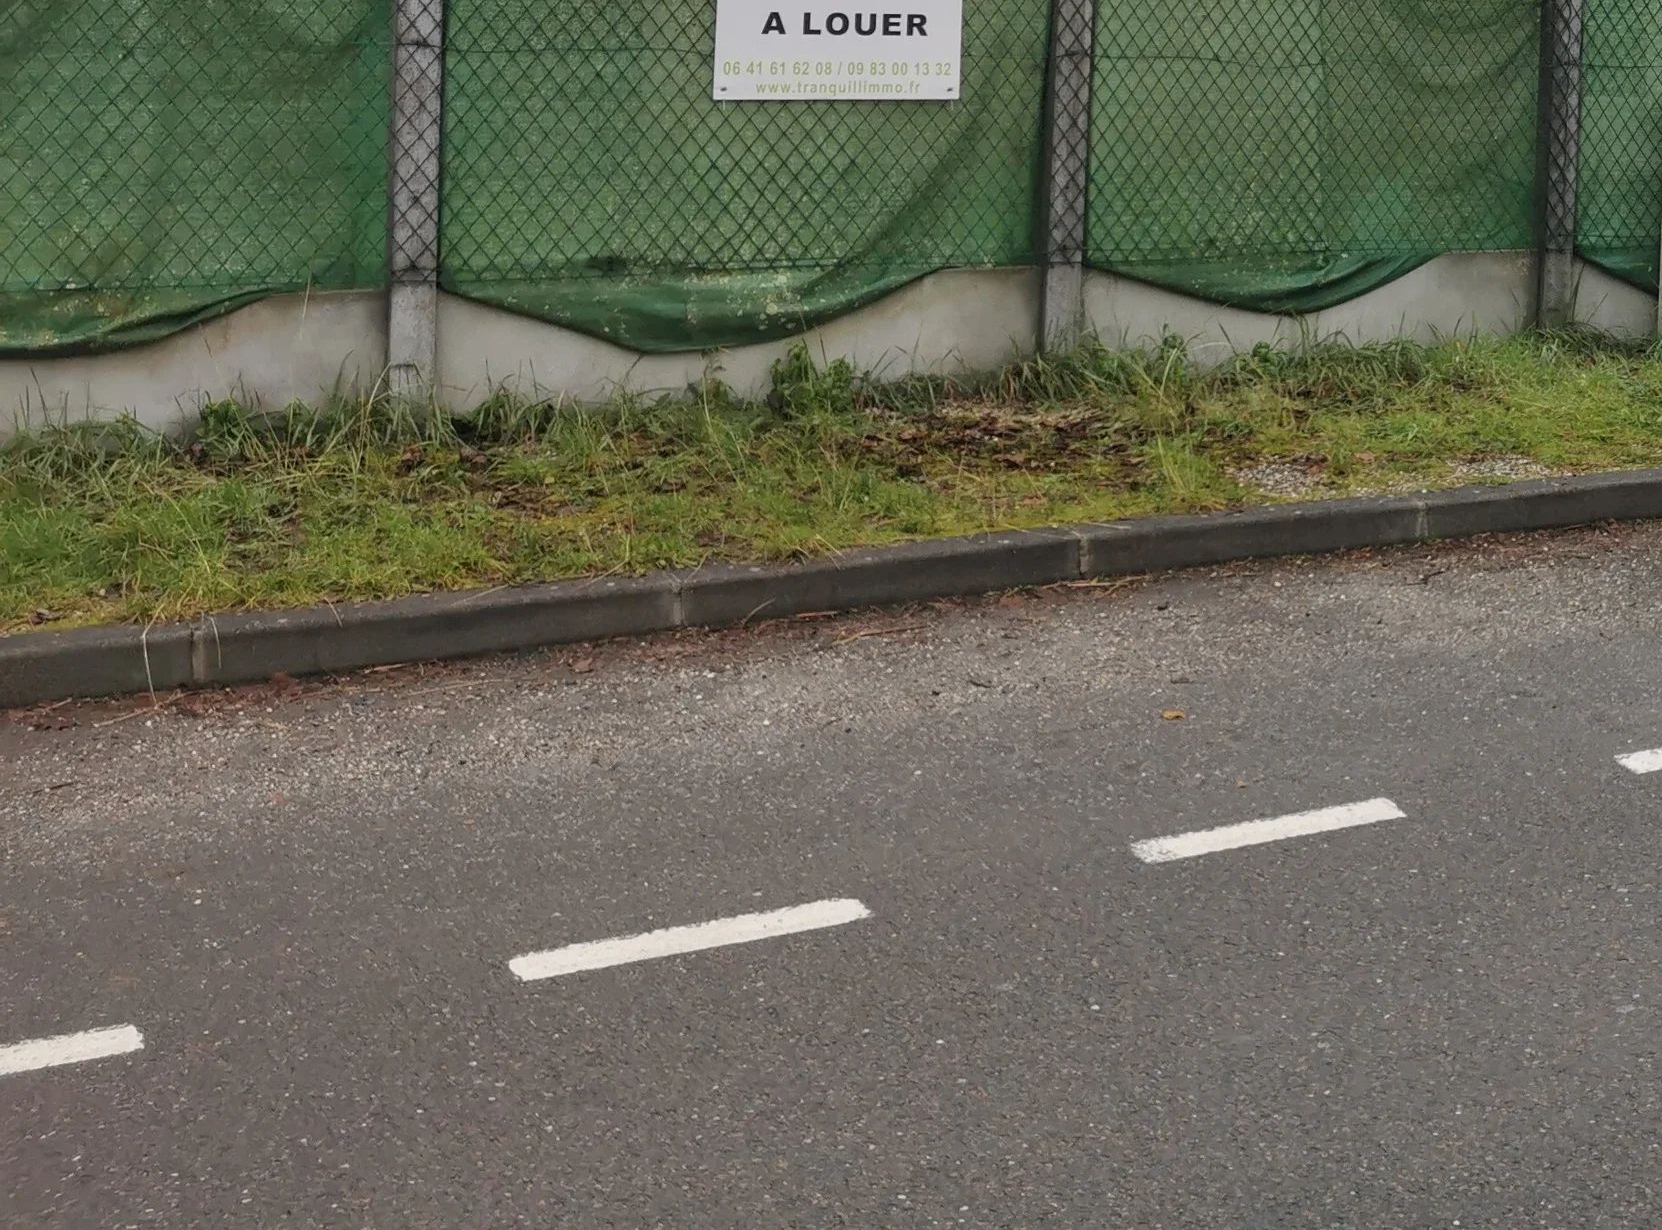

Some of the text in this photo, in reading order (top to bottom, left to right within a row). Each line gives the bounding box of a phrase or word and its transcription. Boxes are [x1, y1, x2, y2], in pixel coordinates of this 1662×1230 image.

[761, 12, 928, 37] A LOUER
[723, 61, 740, 76] 06
[746, 61, 763, 76] 41
[770, 61, 786, 76] 61
[793, 61, 809, 76] 62
[815, 61, 832, 76] 08
[847, 61, 864, 76] 09
[869, 62, 886, 76] 83
[892, 62, 908, 76] 00
[914, 62, 930, 76] 13
[935, 62, 952, 76] 32
[756, 81, 921, 96] www.tranquillimmo.fr
